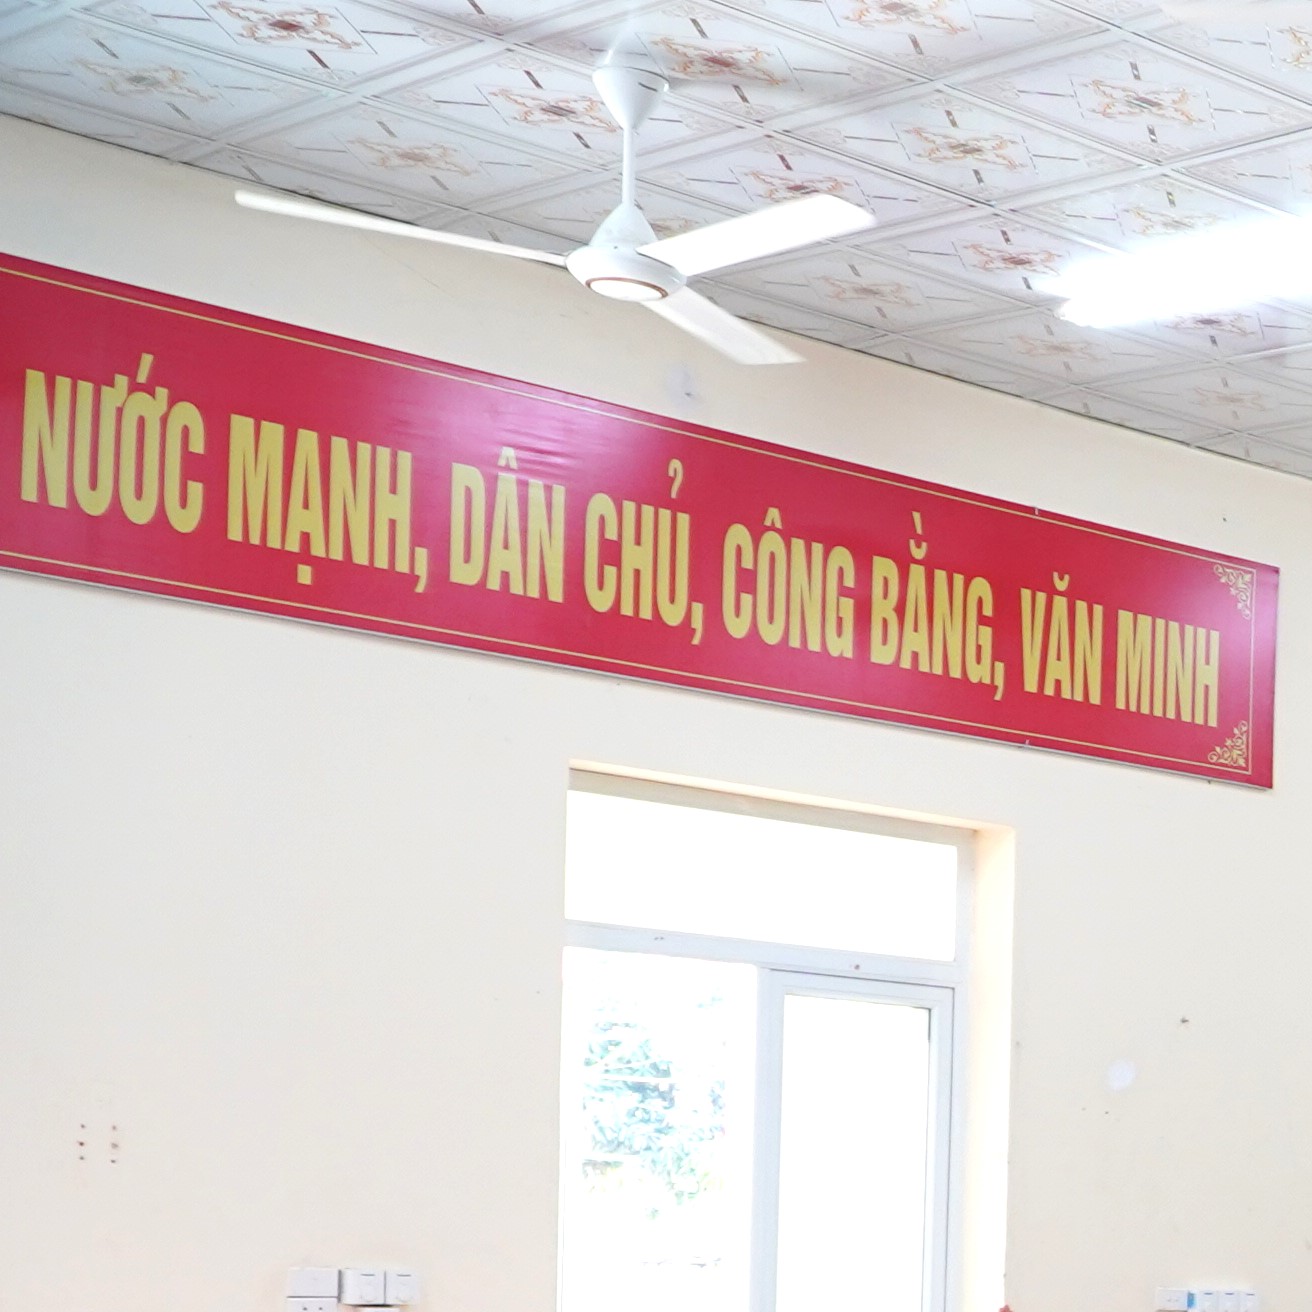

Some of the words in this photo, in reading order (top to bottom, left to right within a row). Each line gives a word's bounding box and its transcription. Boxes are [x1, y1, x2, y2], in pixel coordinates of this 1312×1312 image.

[21, 353, 205, 533] NƯỚC
[227, 414, 428, 593] MẠNH,
[449, 447, 566, 603] DÂN
[584, 459, 704, 645] CHỦ,
[722, 508, 856, 659] CÔNG
[870, 512, 1005, 701] BẰNG,
[1020, 574, 1102, 705] VĂN
[1115, 609, 1220, 727] MINH
